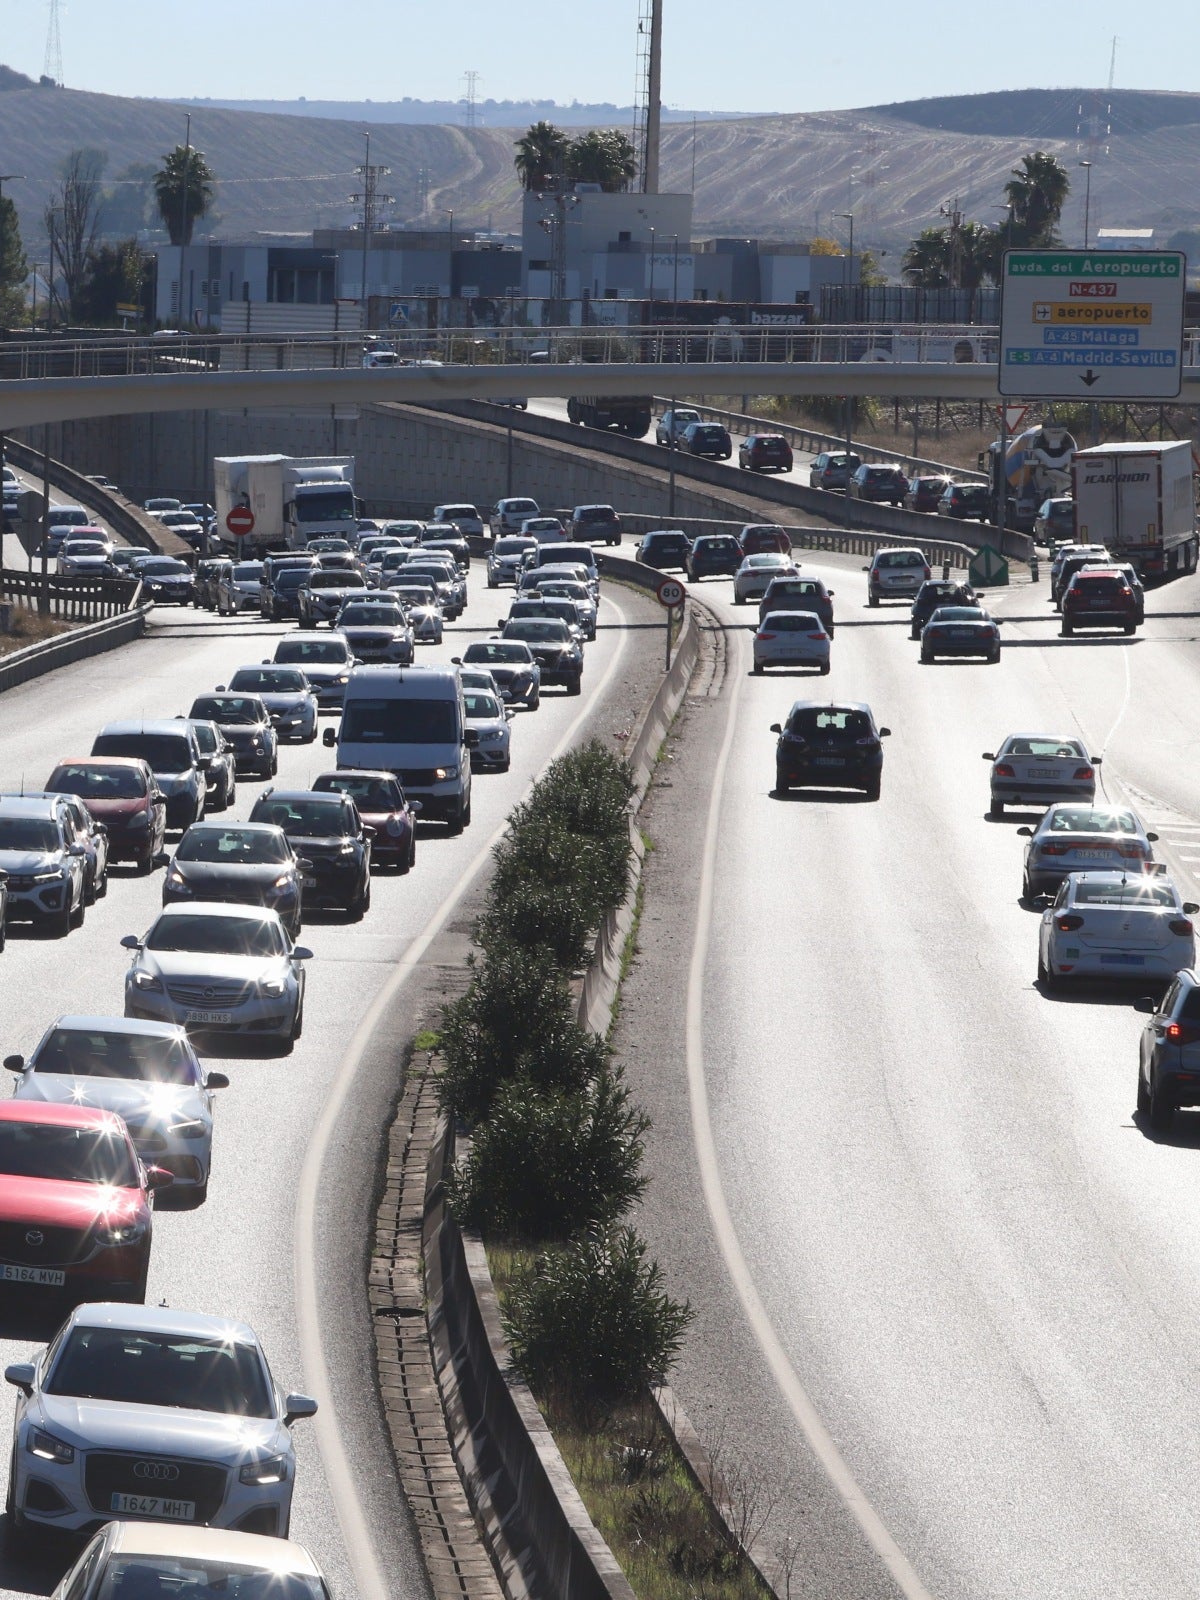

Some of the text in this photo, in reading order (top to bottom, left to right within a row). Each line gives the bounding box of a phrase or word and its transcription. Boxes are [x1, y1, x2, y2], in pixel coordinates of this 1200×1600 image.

[1011, 260, 1176, 275] avda. del Aeropuerto
[1071, 284, 1115, 296] N-437
[1057, 306, 1149, 320] aeropuerto
[1047, 330, 1077, 341] A-45
[1009, 351, 1173, 365] E-5 A-4 Madrid-Sevilla
[663, 587, 680, 598] 80
[5, 1266, 63, 1284] 5164 MVH
[122, 1495, 191, 1517] 1647 MHT
